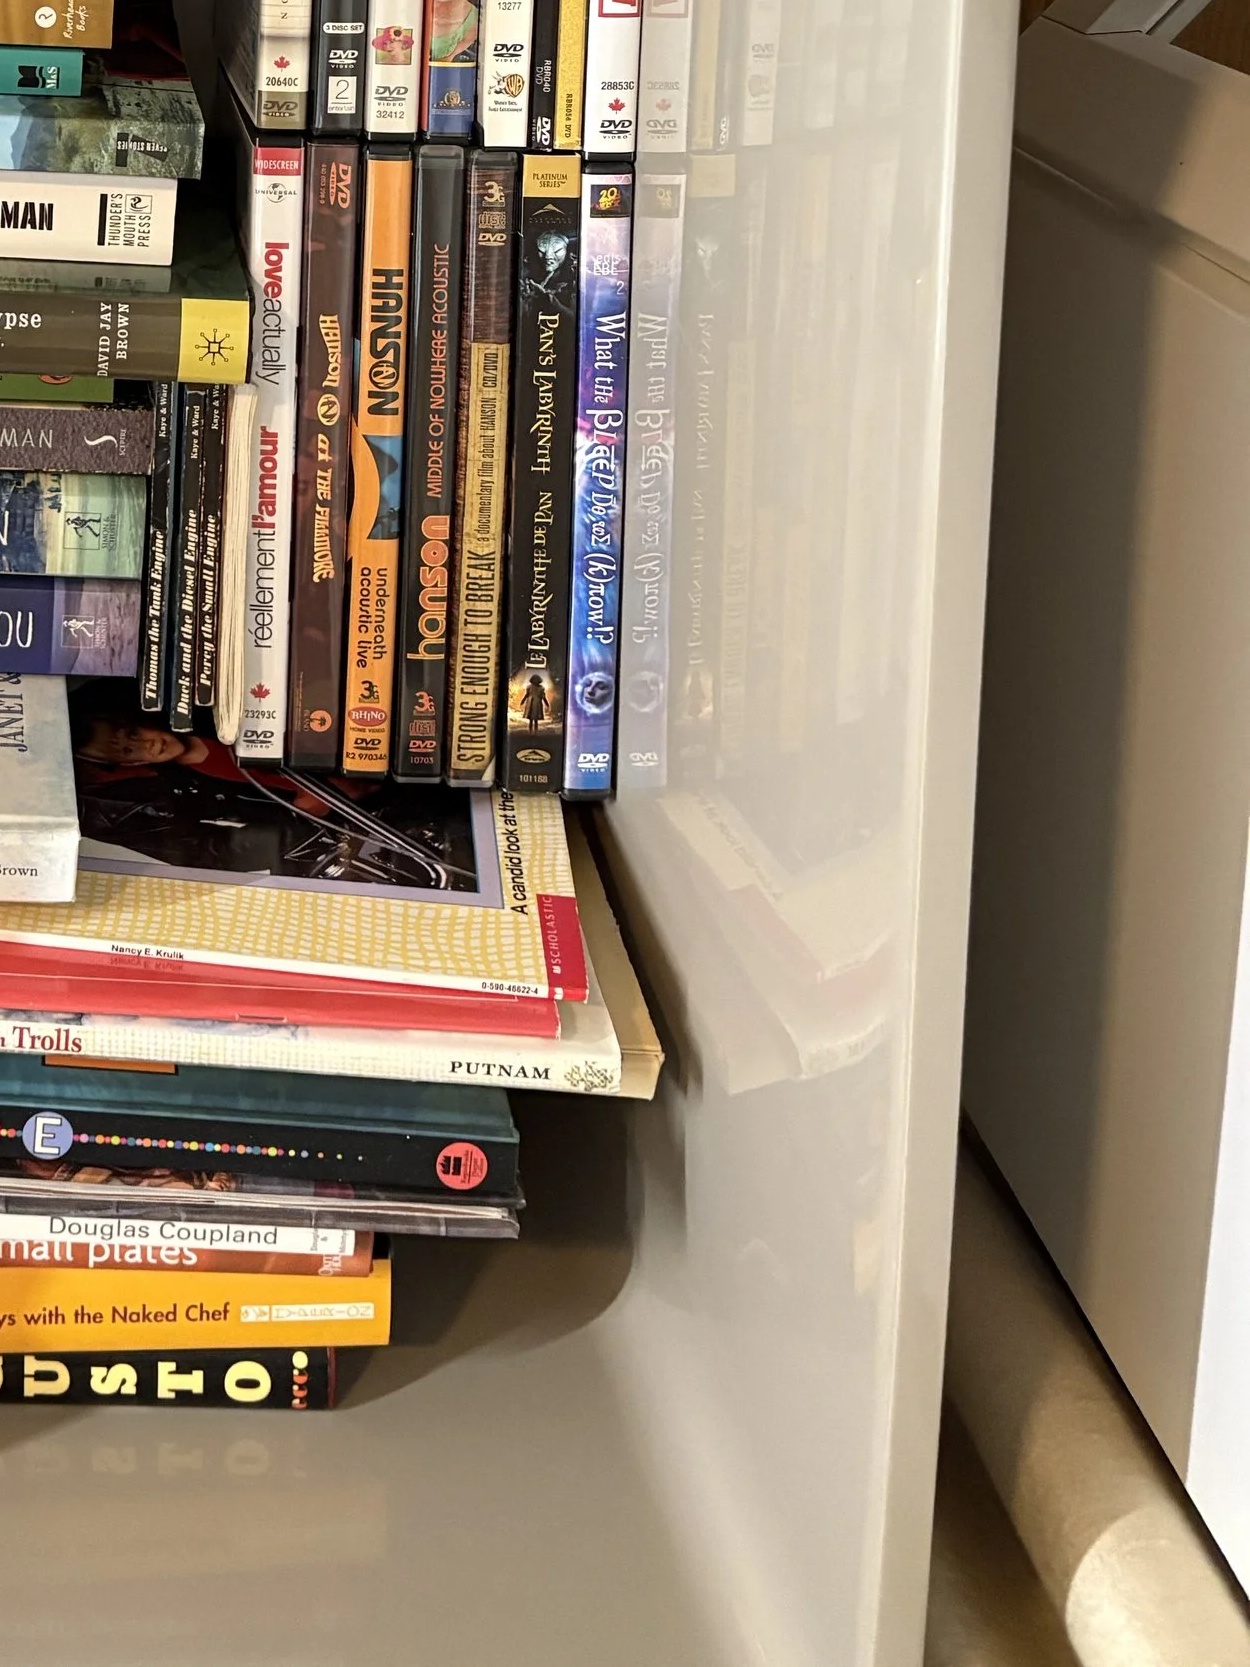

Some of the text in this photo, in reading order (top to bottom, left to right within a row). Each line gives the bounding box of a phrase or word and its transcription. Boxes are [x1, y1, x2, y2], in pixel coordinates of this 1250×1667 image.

[367, 267, 404, 417] HANSON
[529, 311, 560, 475] PAN'S LABYRINTH
[356, 566, 372, 669] acoustic live
[372, 566, 388, 661] underneath
[407, 515, 451, 660] hanson
[457, 549, 497, 764] STRONG ENOUGH TO BREAK
[12, 1026, 83, 1054] Trolls
[449, 1060, 551, 1081] PUTNAM
[49, 1216, 150, 1242] Douglas
[159, 1221, 279, 1246] Coupland
[20, 1304, 65, 1326] with
[69, 1304, 105, 1325] the
[112, 1303, 178, 1324] Naked
[185, 1301, 231, 1322] Chef
